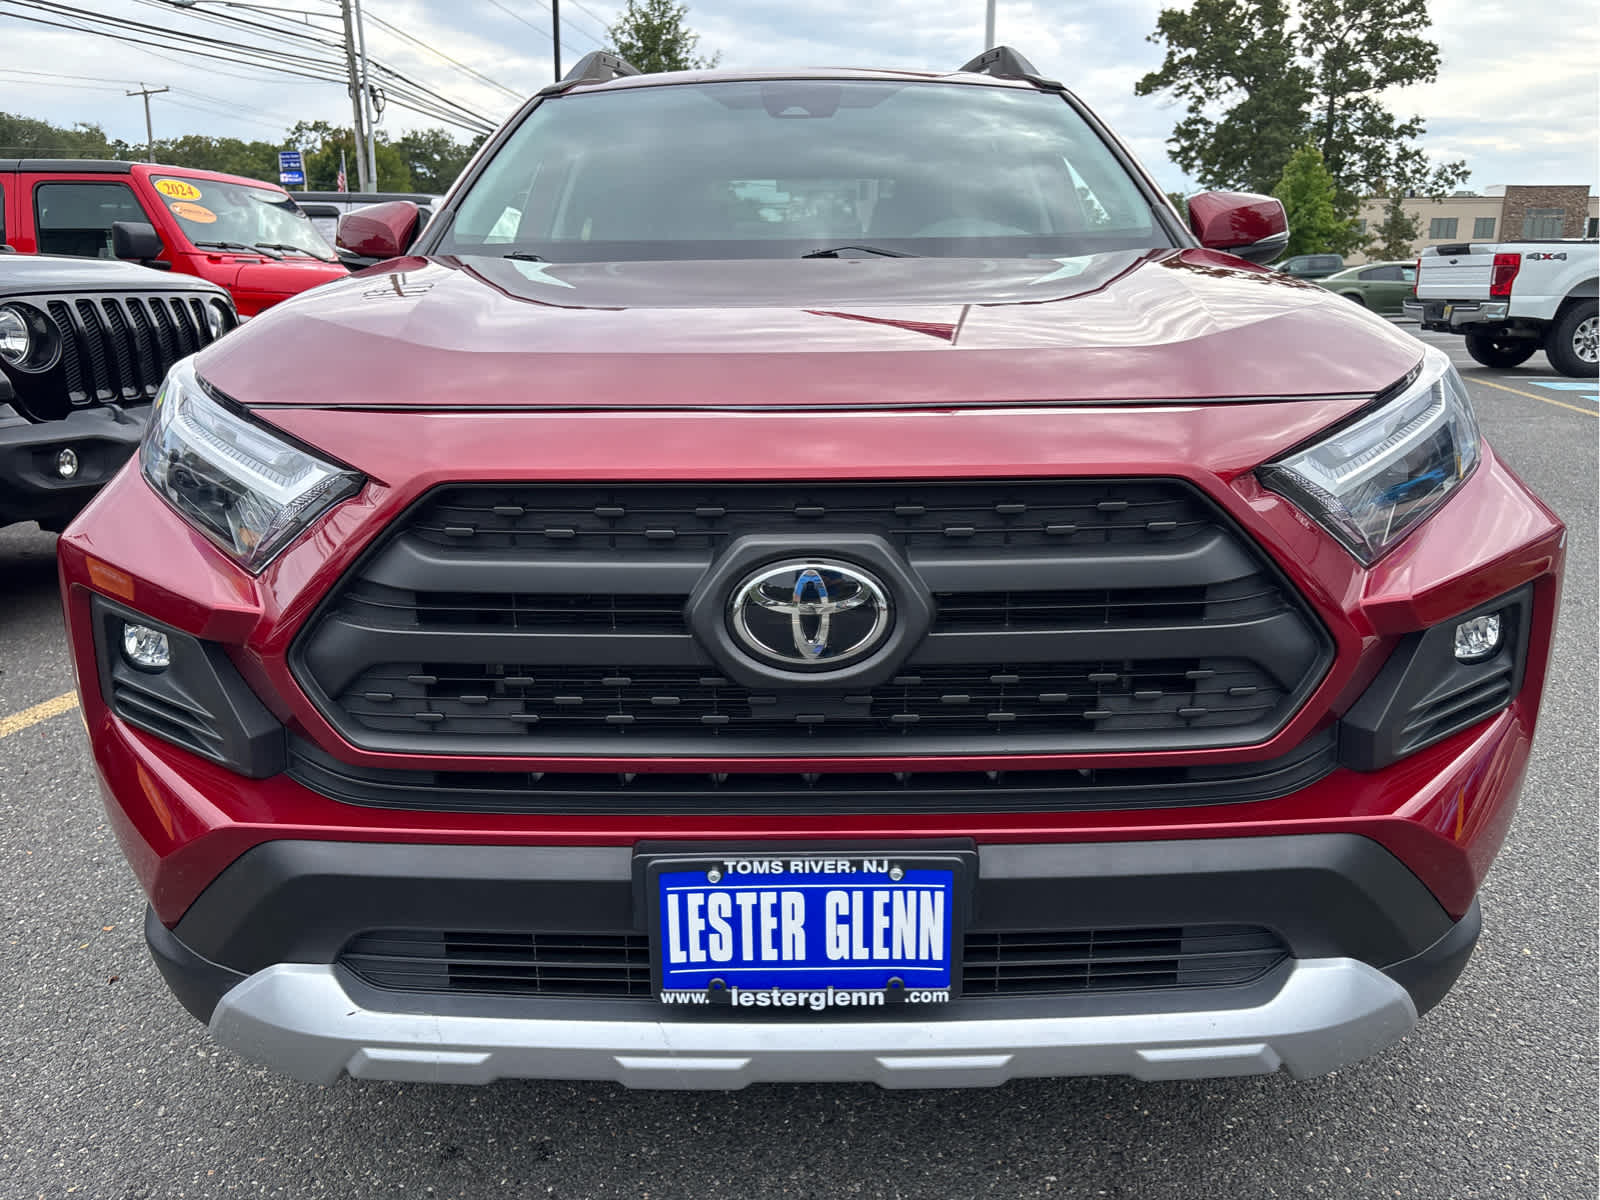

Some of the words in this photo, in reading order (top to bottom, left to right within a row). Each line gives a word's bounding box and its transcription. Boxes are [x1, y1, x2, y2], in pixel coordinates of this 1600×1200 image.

[163, 183, 194, 196] 2024
[723, 861, 784, 875] TOMS
[789, 860, 857, 874] RIVER,
[863, 860, 889, 874] NJ
[666, 891, 807, 964] LESTER
[825, 890, 945, 961] GLENN
[660, 991, 710, 1005] www.
[731, 987, 885, 1011] lesterglenn
[904, 989, 949, 1004] .com
